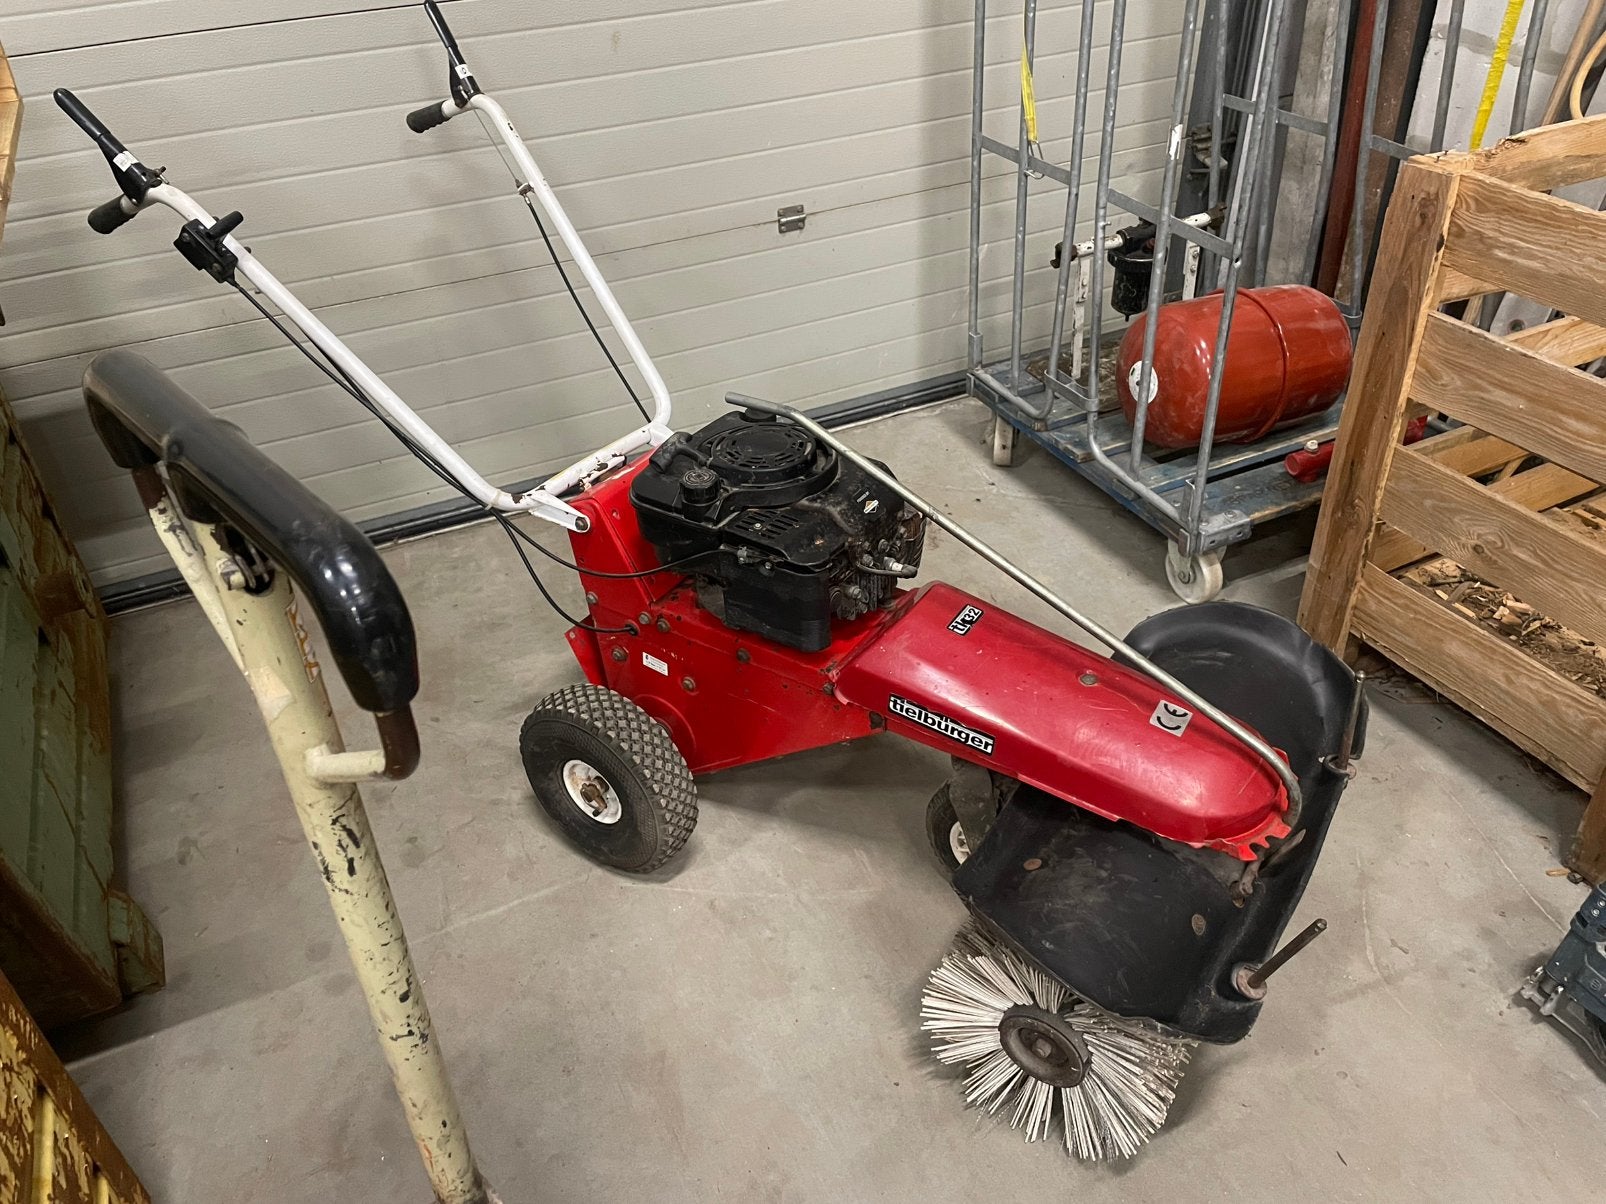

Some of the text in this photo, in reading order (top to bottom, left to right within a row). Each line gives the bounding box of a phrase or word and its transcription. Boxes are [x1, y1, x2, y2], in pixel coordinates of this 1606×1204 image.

[963, 608, 980, 622] 32
[889, 697, 994, 751] tielbürger
[1156, 703, 1189, 731] CE
